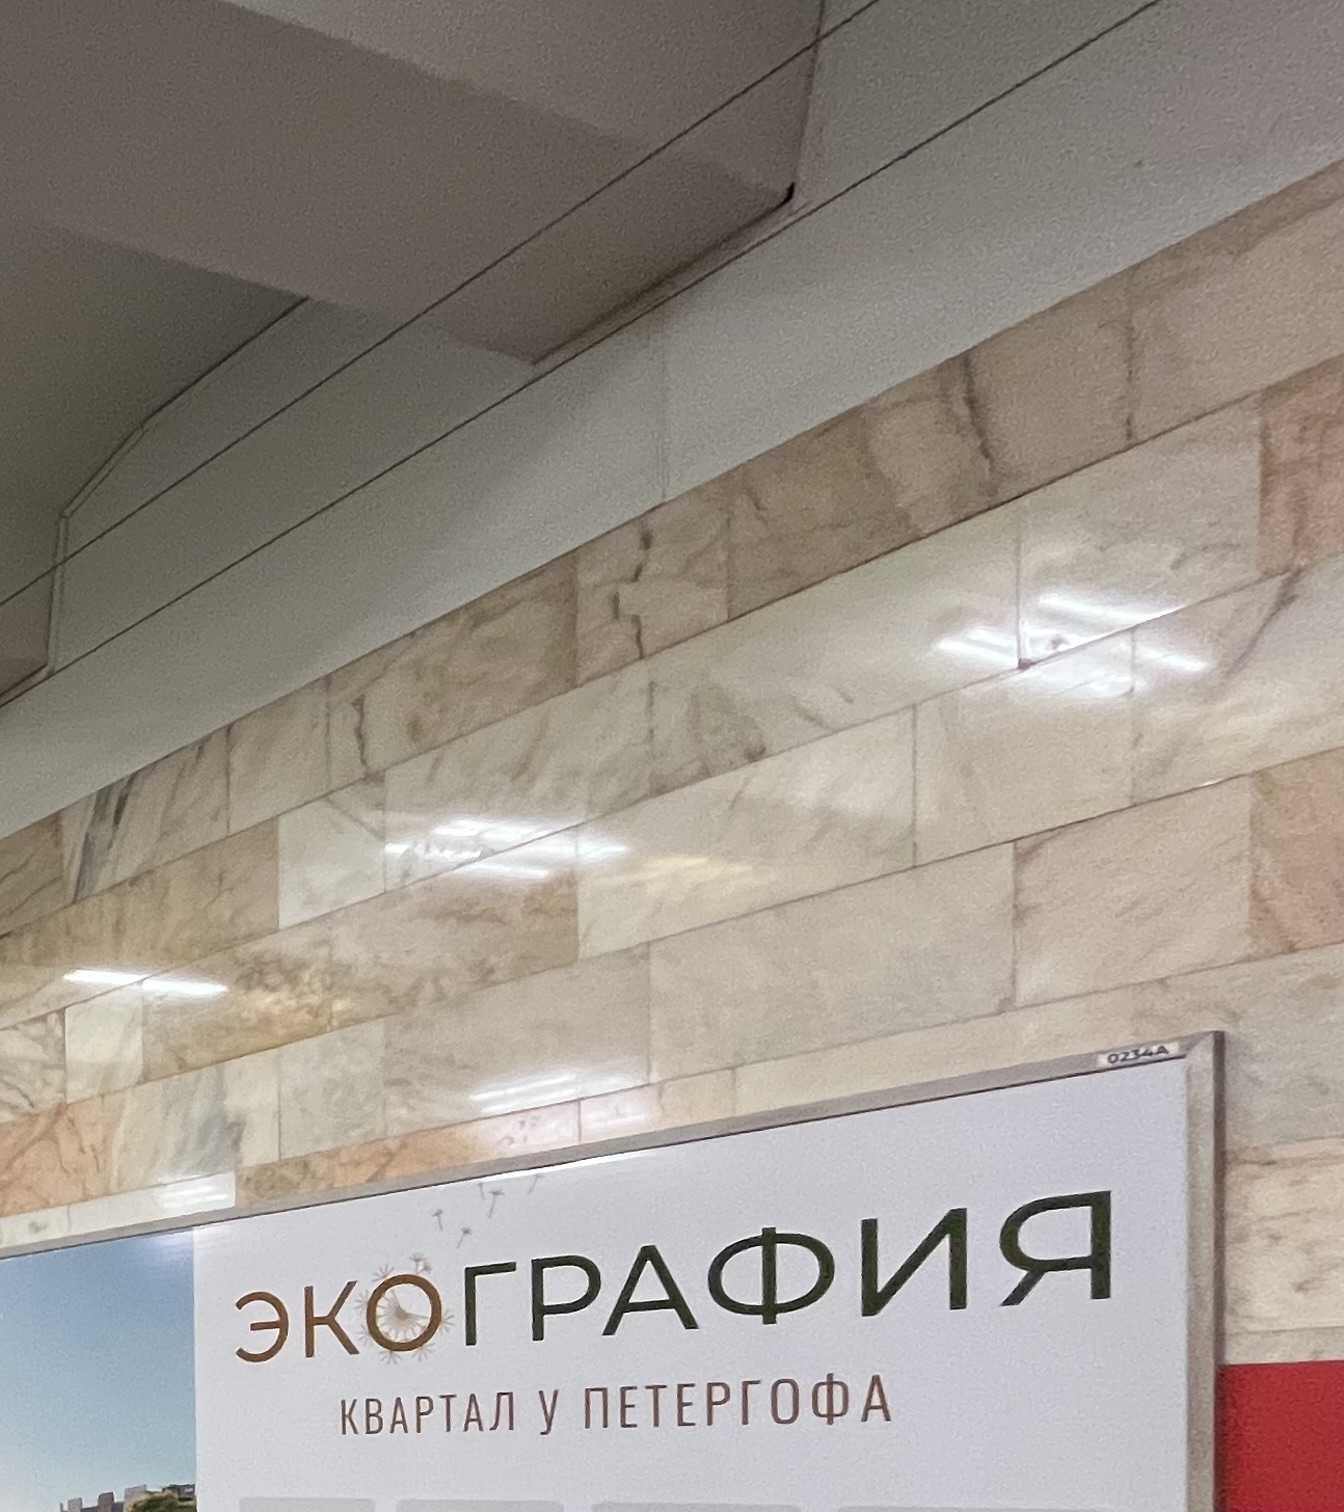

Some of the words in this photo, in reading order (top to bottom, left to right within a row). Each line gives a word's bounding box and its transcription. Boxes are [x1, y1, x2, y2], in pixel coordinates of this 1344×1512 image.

[234, 1190, 1112, 1362] ЭКОГРАФИЯ
[340, 1392, 515, 1436] КВАРТАЛ
[539, 1389, 559, 1436] У
[584, 1372, 892, 1429] ПЕТЕРГОФА
